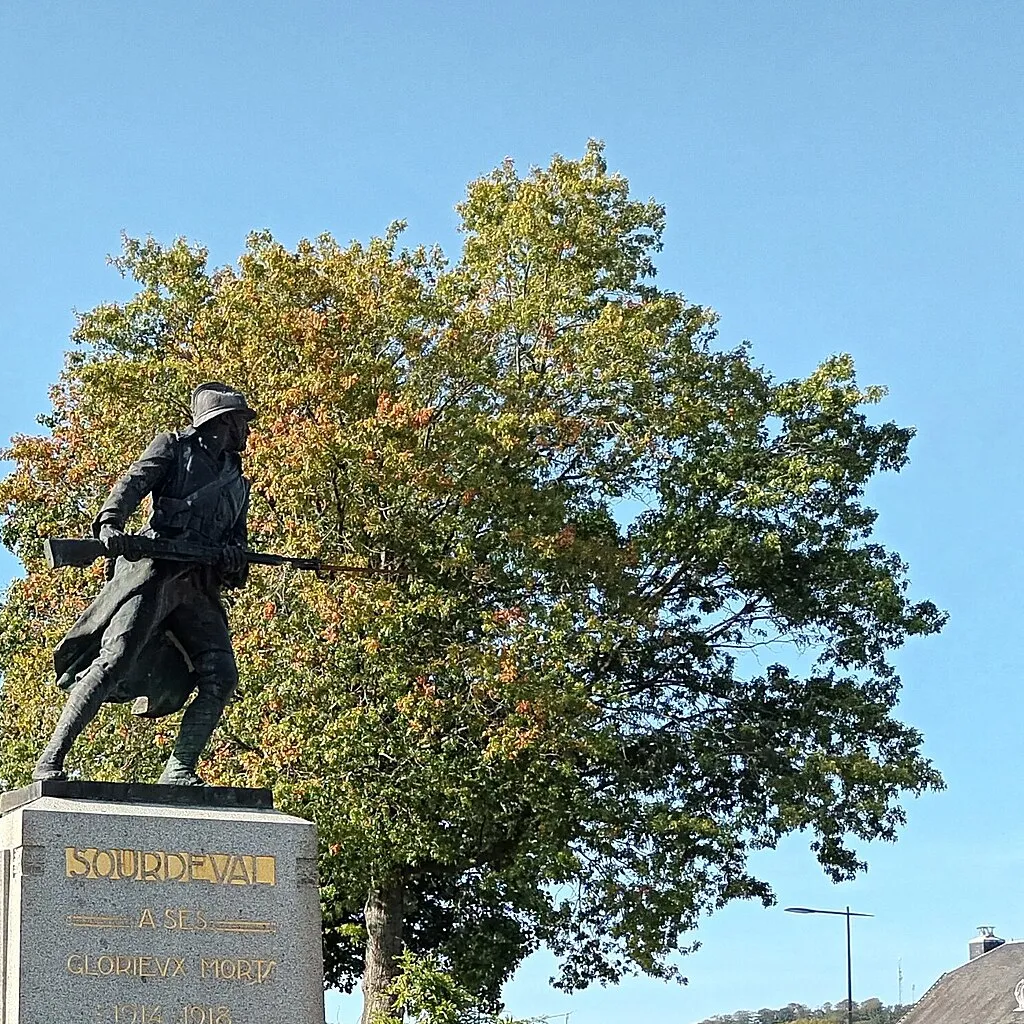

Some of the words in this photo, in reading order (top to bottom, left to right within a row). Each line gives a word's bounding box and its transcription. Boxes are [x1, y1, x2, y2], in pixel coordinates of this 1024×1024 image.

[66, 847, 276, 886] SOURDEVAL
[138, 908, 156, 929] A
[164, 908, 208, 931] SES
[67, 954, 187, 978] GLORIEVX
[201, 957, 277, 985] MORTS
